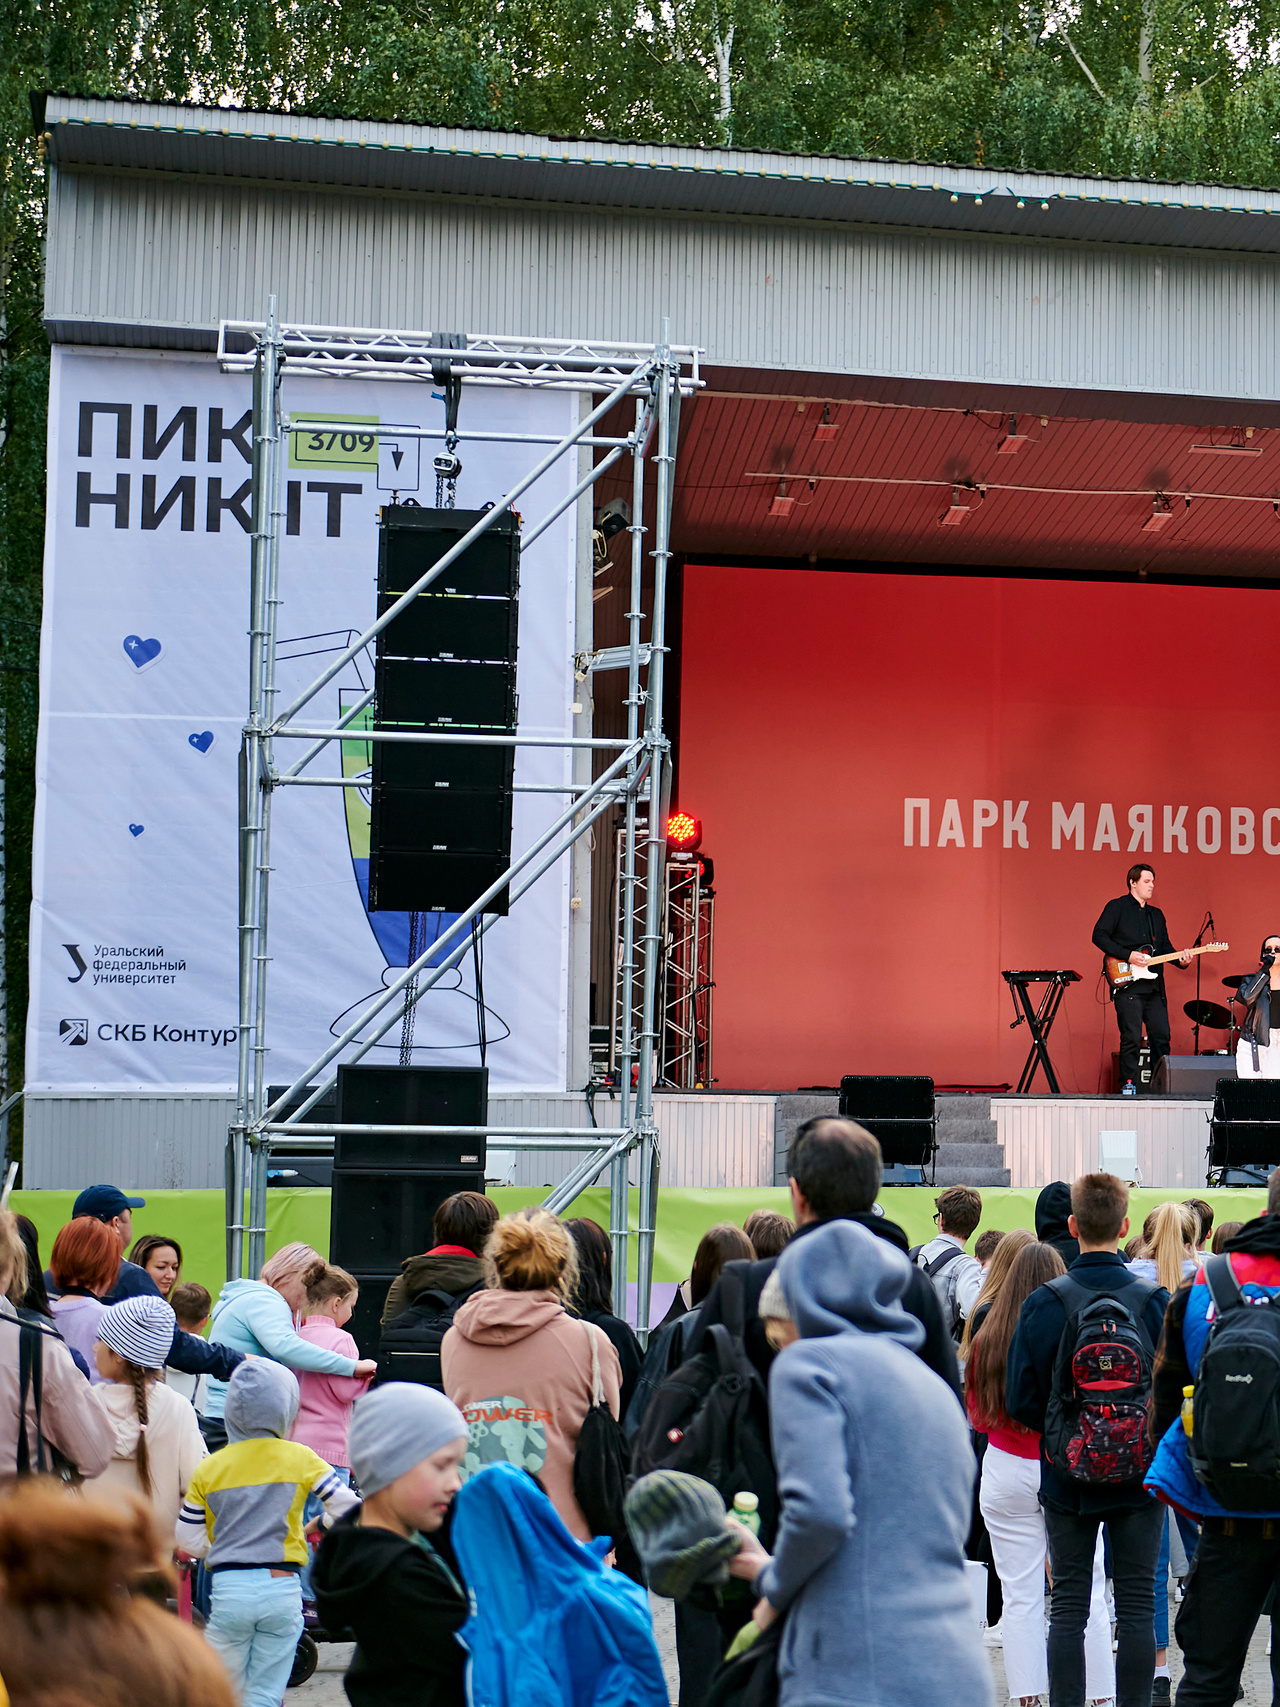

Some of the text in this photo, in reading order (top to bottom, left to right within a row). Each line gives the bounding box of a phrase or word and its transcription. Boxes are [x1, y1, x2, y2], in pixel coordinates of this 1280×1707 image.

[77, 401, 253, 464] ПИК
[308, 431, 375, 453] 3/09
[75, 471, 363, 538] НИК IT
[903, 797, 1030, 849] ПАРК
[94, 944, 164, 958] Уральский
[92, 959, 187, 972] федеральный
[92, 973, 177, 986] университет
[97, 1023, 238, 1046] СКБ Контур
[462, 1407, 554, 1426] OWER
